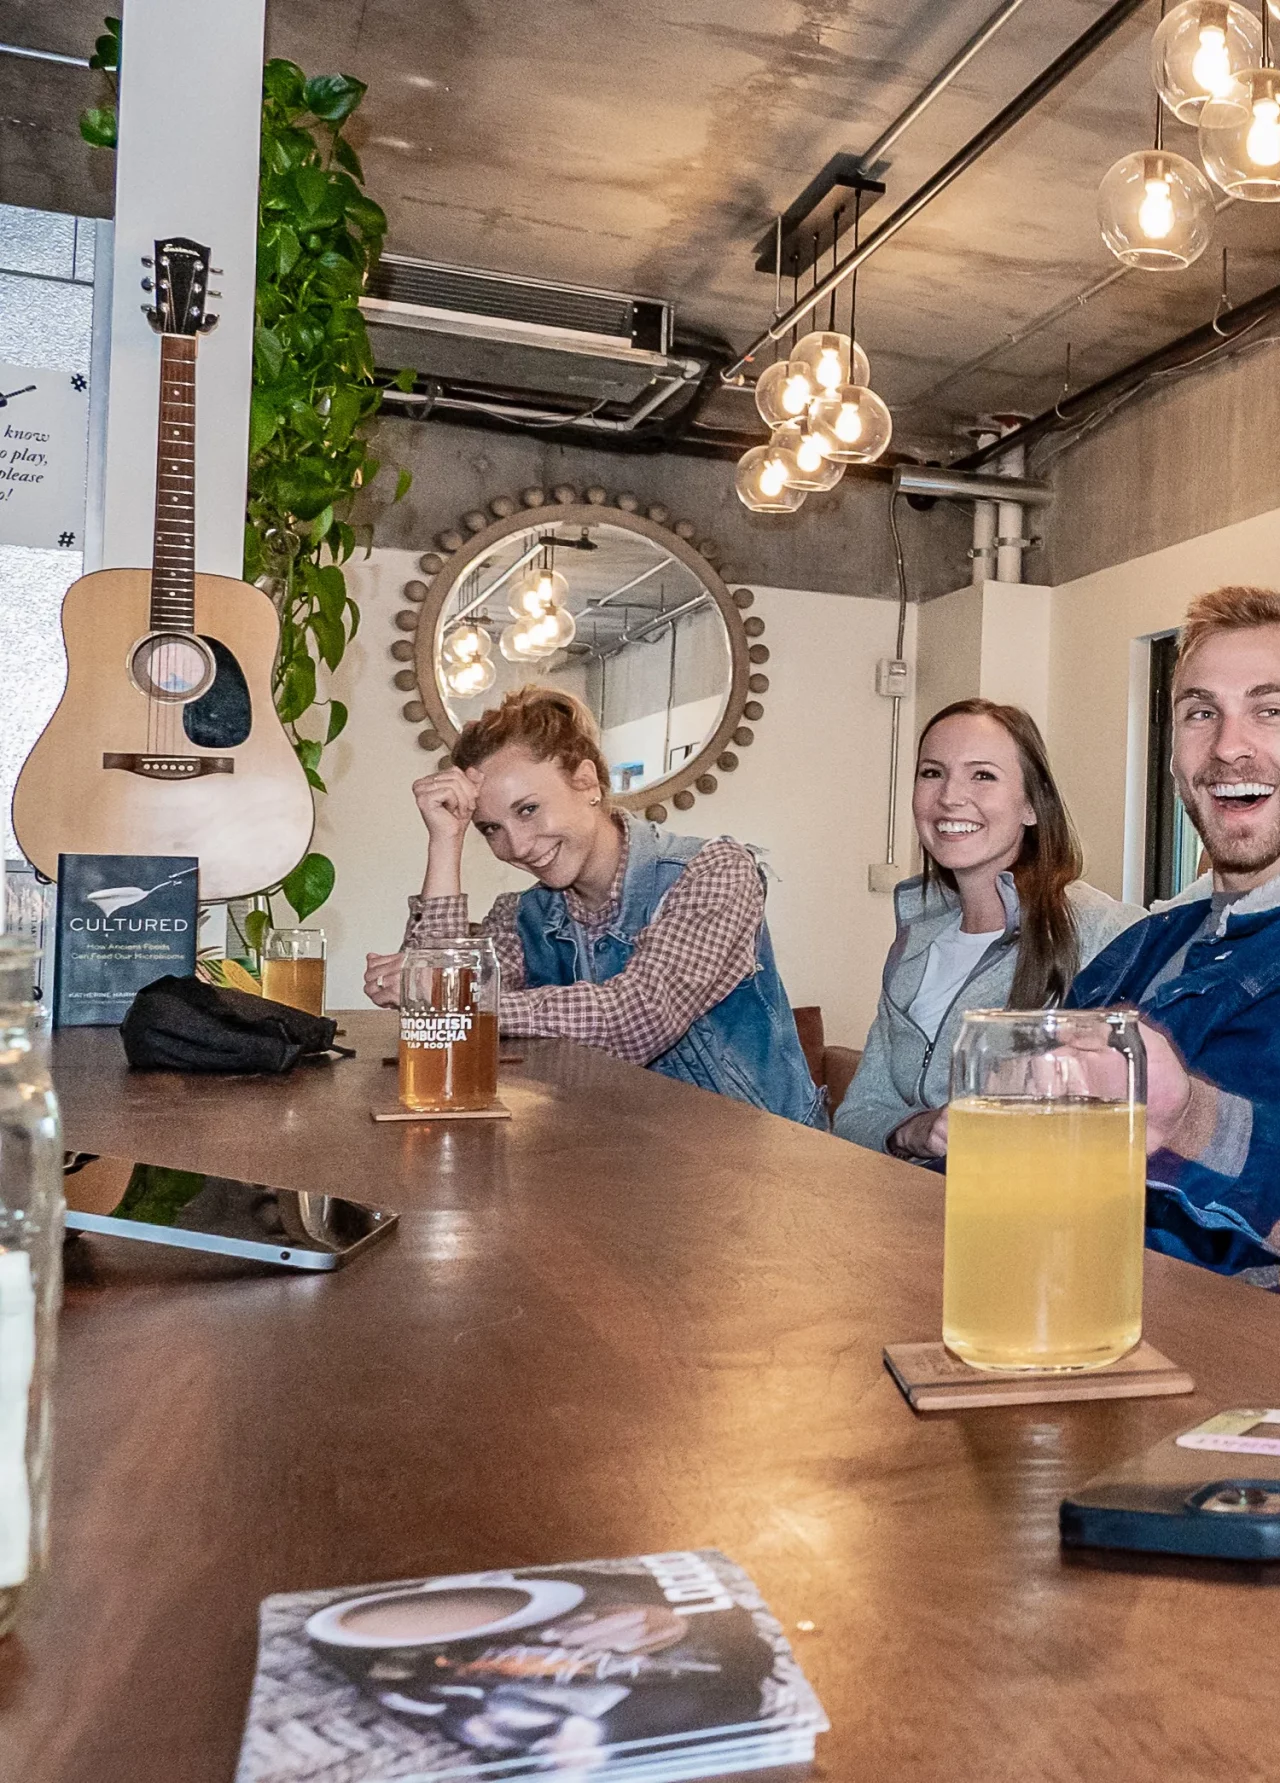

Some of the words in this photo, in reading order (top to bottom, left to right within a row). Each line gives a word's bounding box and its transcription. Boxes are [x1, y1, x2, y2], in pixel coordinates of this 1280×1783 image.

[4, 424, 50, 442] know
[0, 449, 8, 459] o
[9, 447, 48, 467] play,
[0, 488, 14, 501] o!
[69, 917, 189, 932] CULTURED
[87, 943, 106, 951] How
[115, 952, 133, 960] Our
